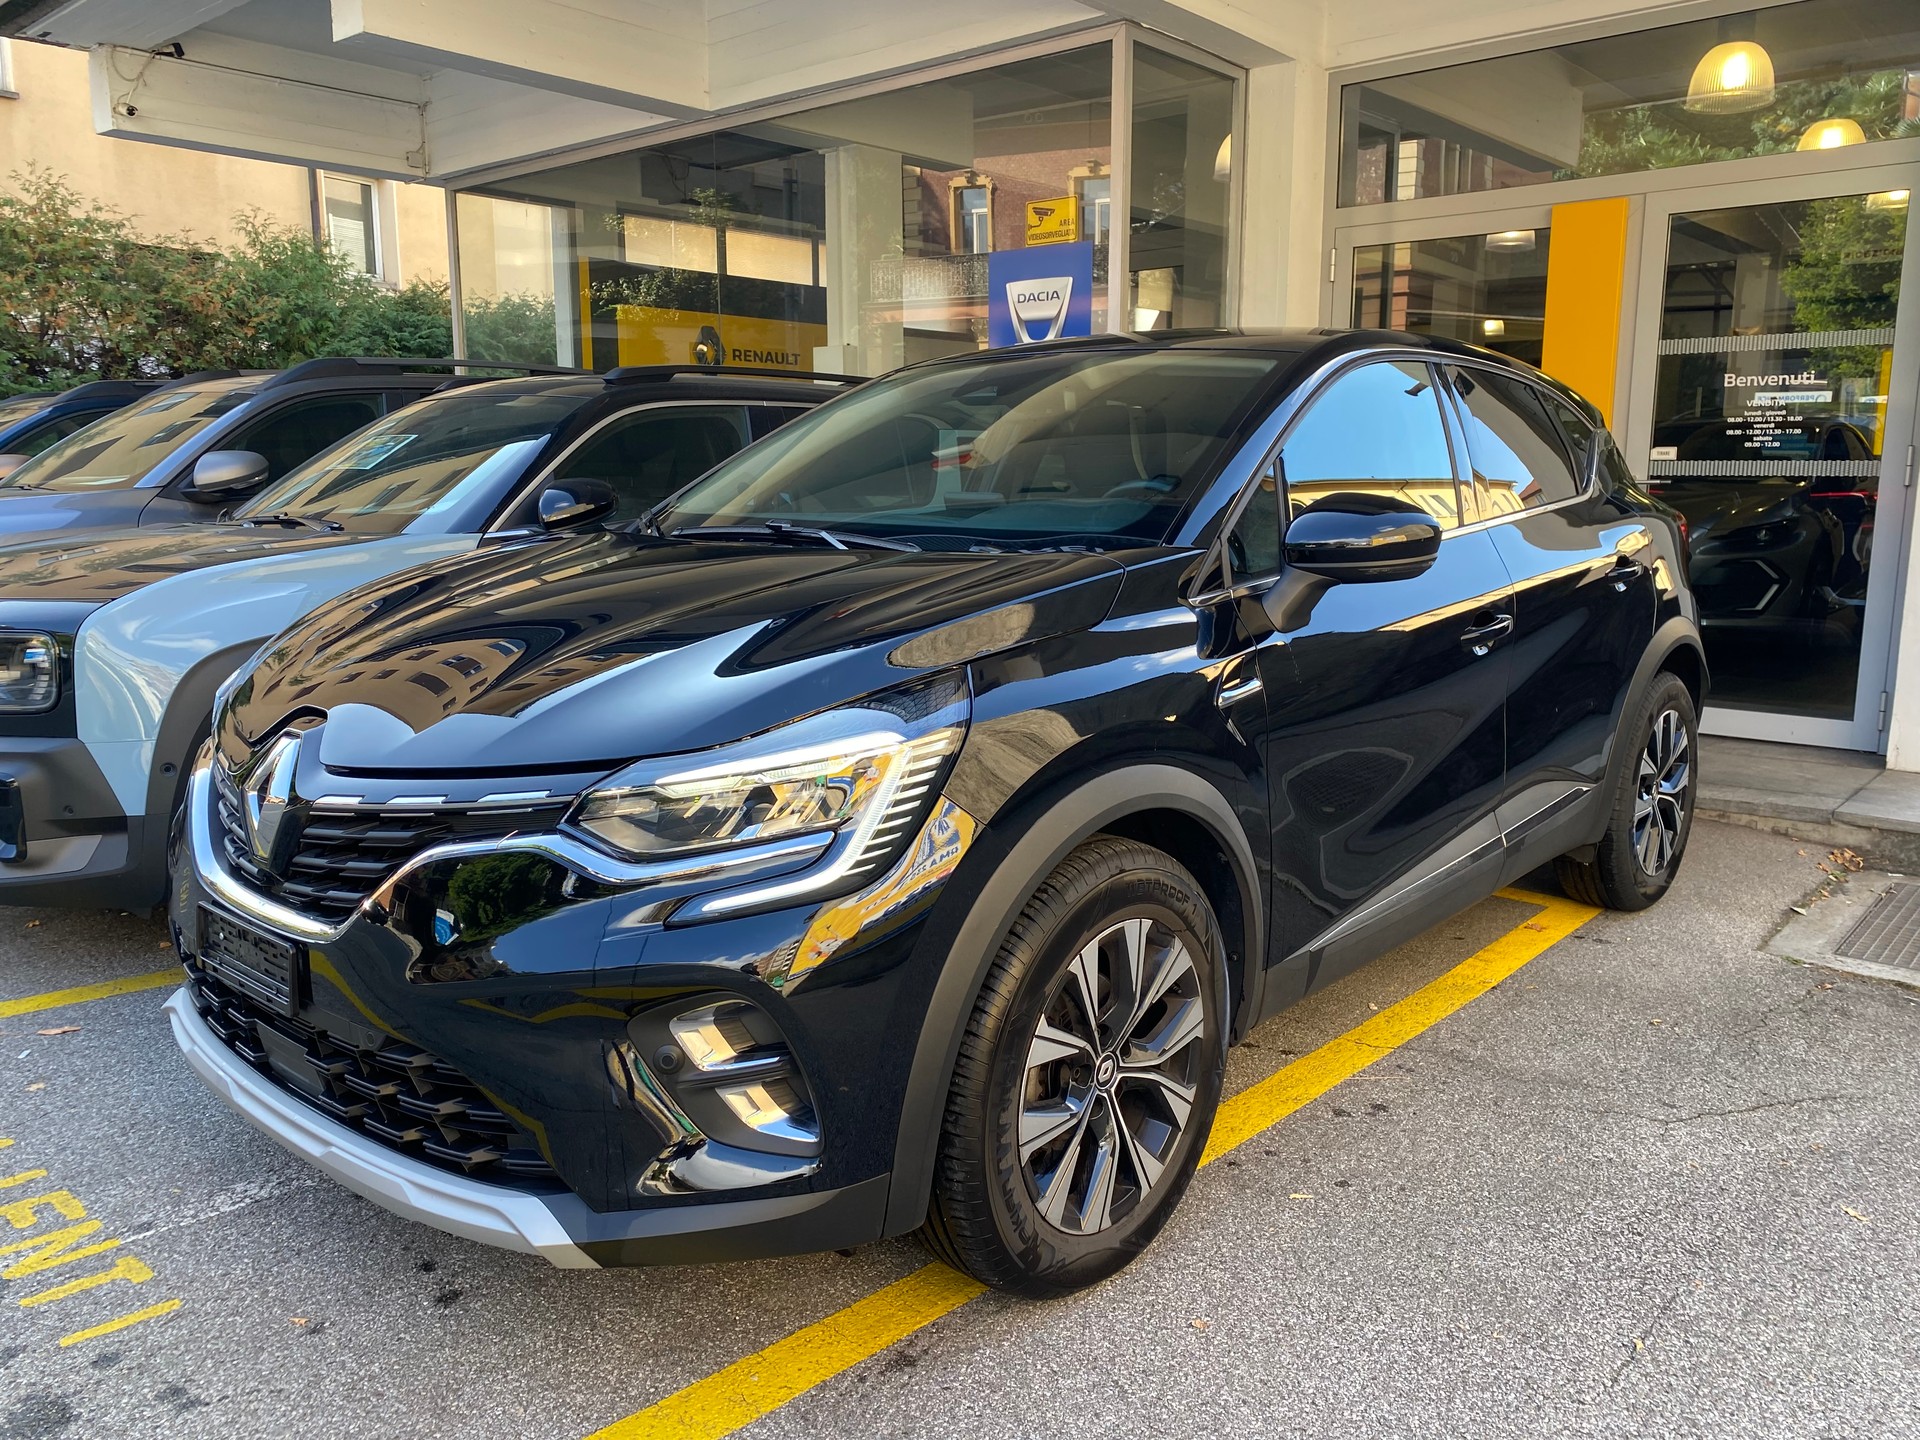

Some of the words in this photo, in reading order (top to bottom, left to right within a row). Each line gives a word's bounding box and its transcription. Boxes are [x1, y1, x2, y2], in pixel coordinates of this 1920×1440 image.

[1059, 217, 1075, 227] AREA
[1017, 290, 1060, 304] DACIA
[732, 348, 801, 366] RENAULT
[1724, 370, 1816, 387] Benvenuti
